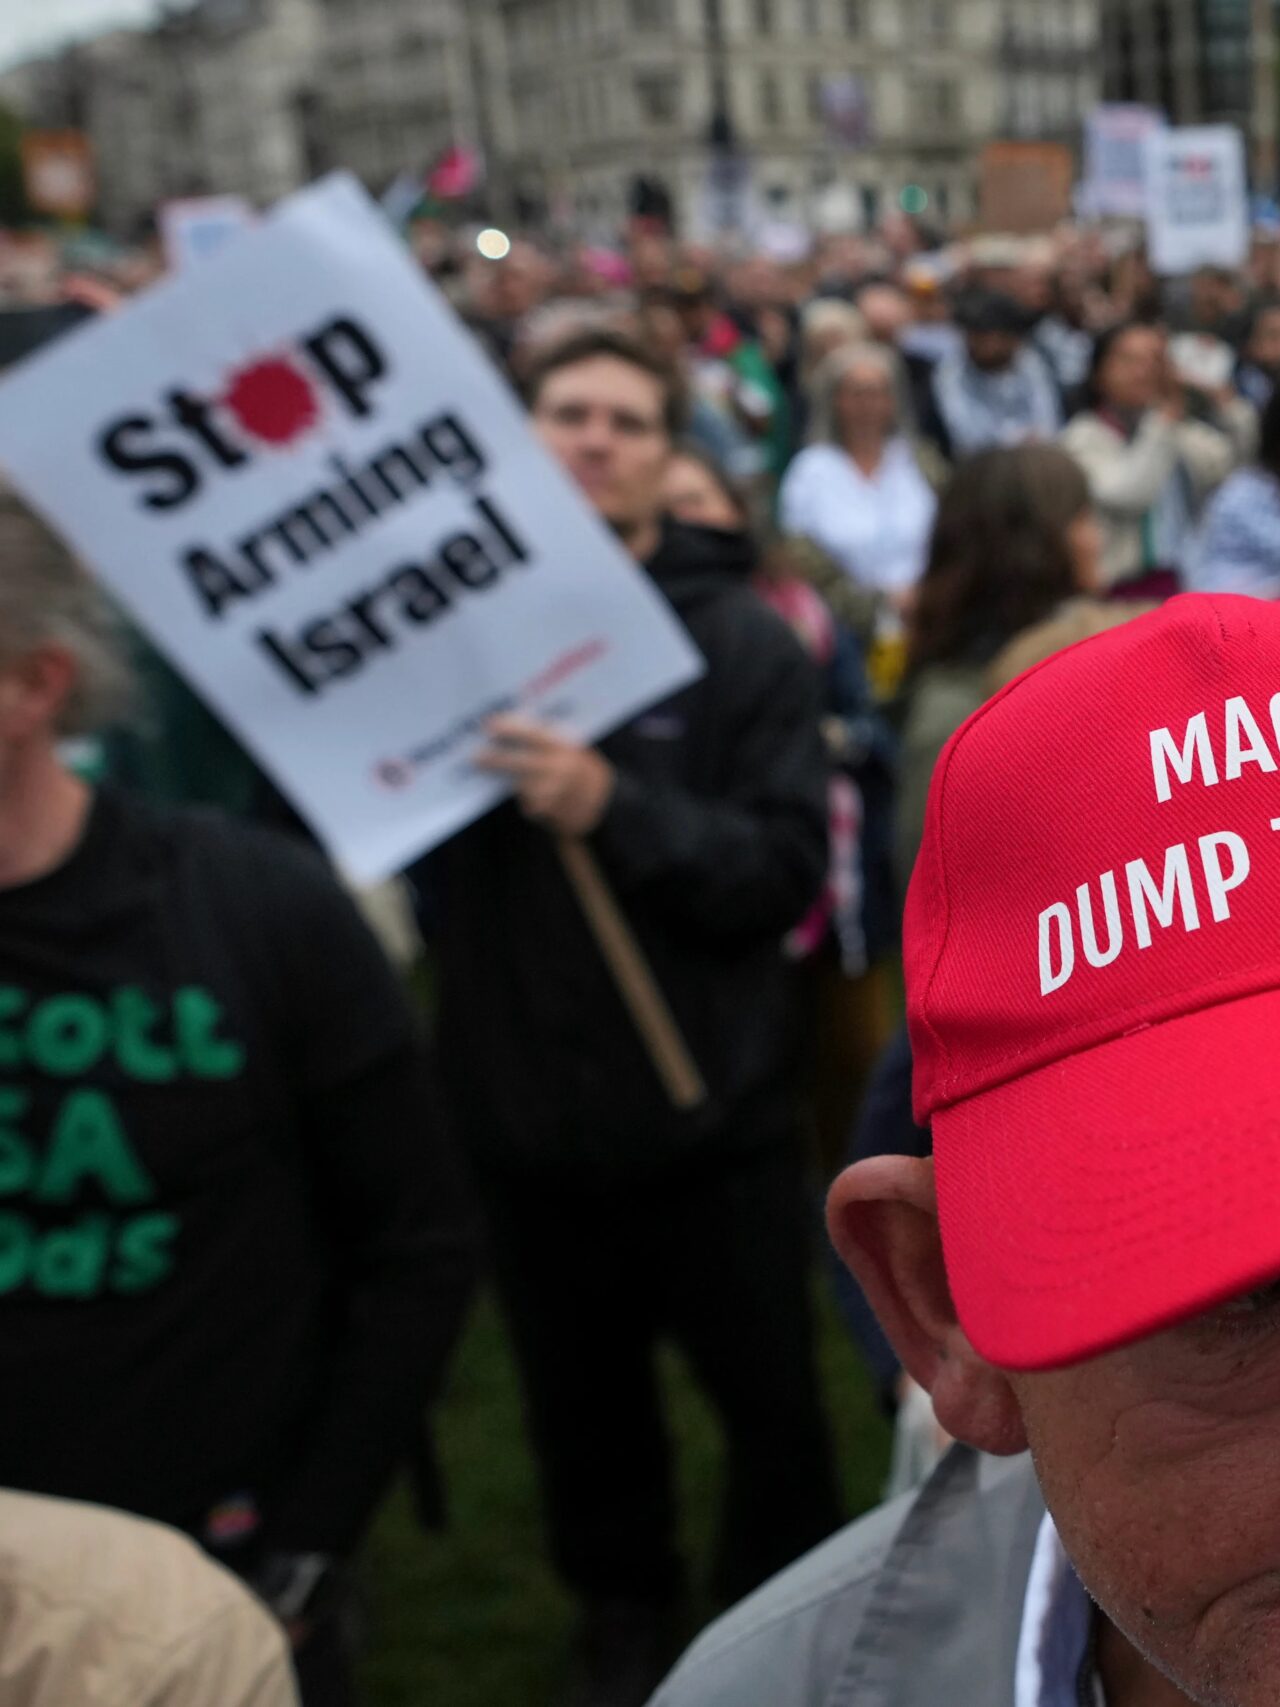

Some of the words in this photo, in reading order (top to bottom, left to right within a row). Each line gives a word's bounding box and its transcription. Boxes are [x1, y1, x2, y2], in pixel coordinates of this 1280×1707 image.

[95, 314, 388, 515] Stop
[180, 411, 486, 620] Arming
[255, 495, 530, 699] Israel
[1038, 830, 1250, 997] DUMP
